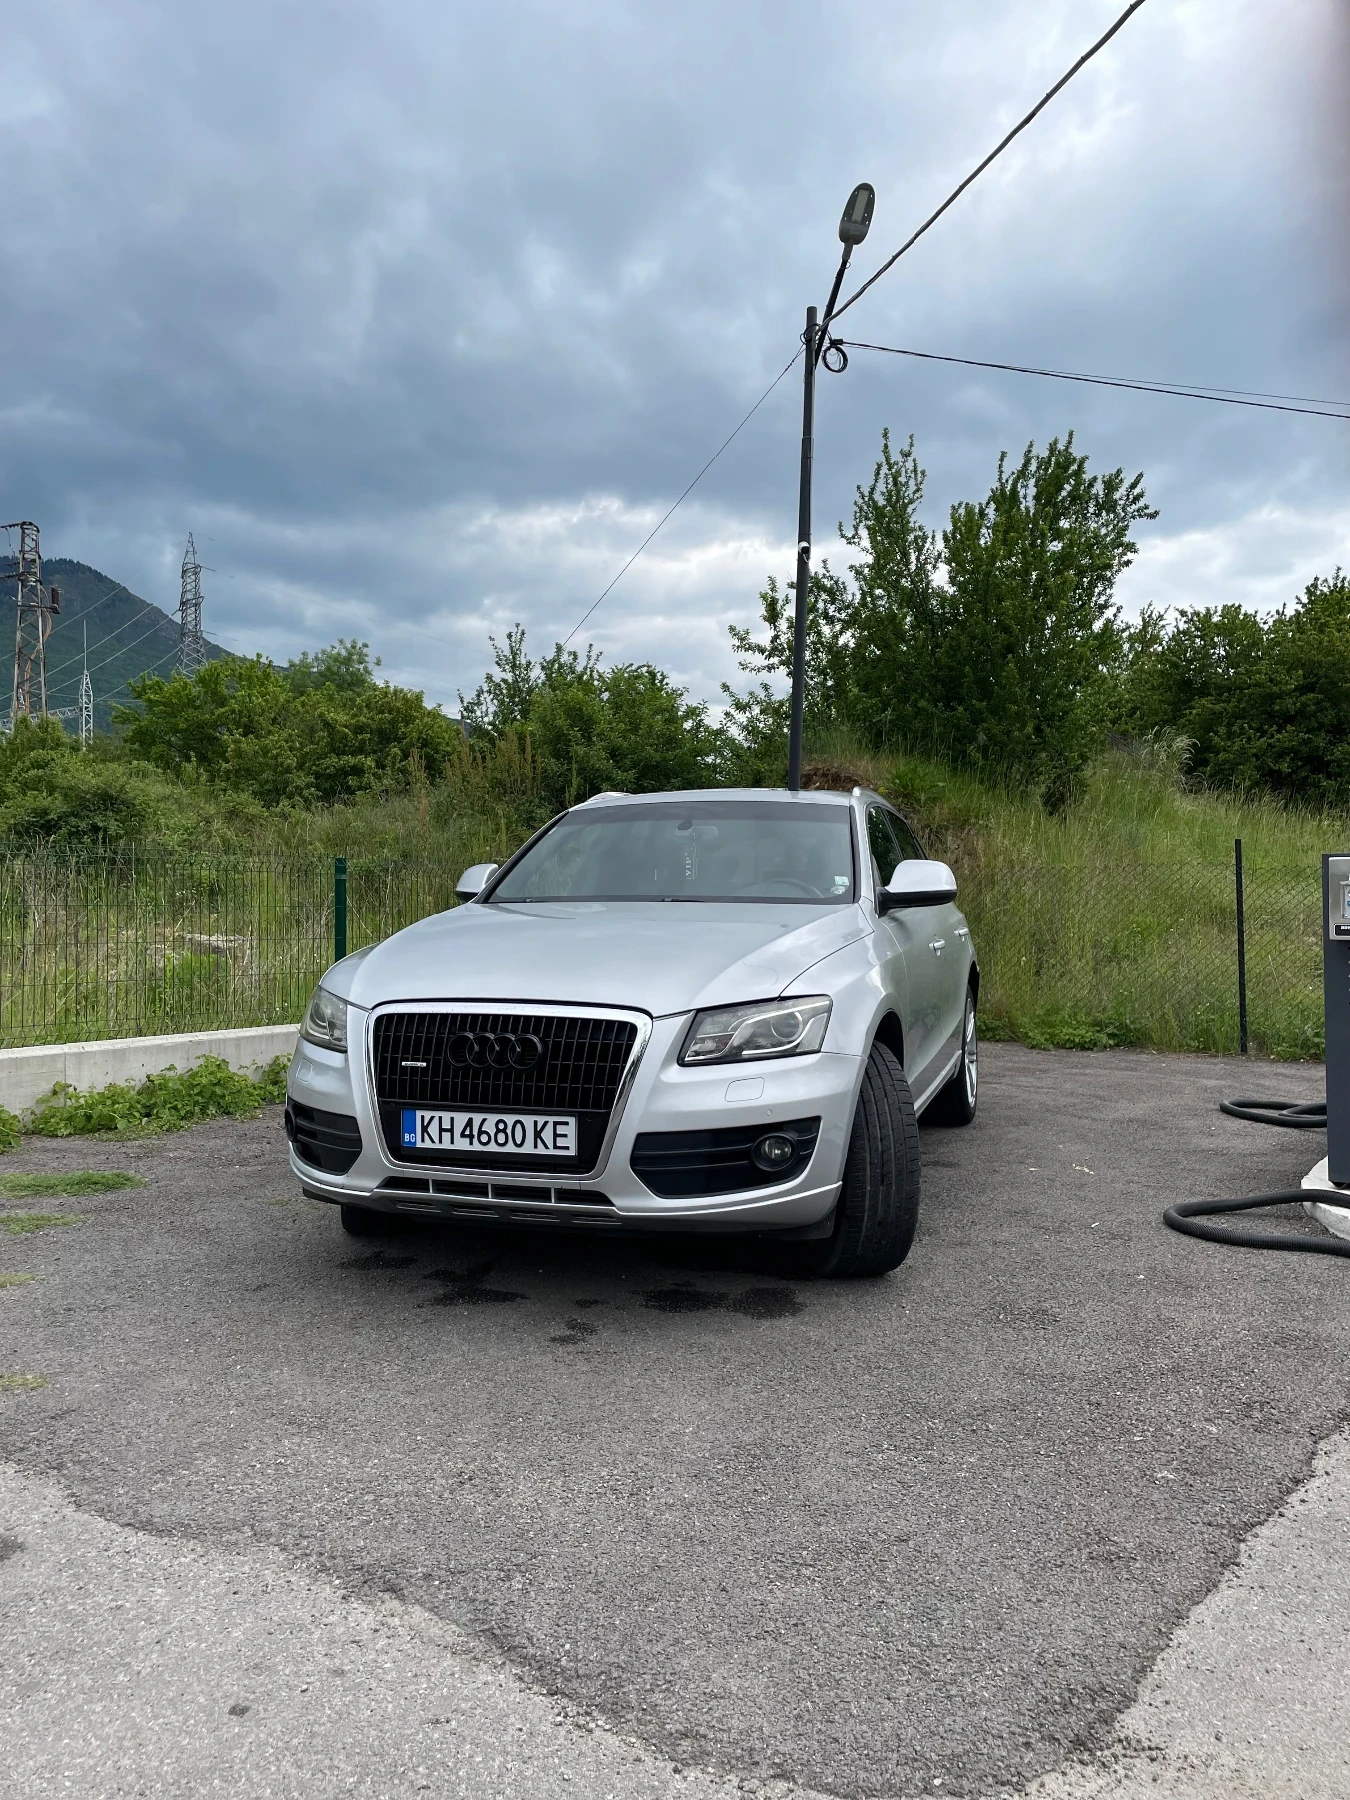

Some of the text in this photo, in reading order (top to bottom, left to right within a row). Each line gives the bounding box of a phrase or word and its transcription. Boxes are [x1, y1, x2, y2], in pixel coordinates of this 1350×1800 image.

[404, 1133, 416, 1143] BG
[420, 1114, 570, 1150] KH 4680 KE
